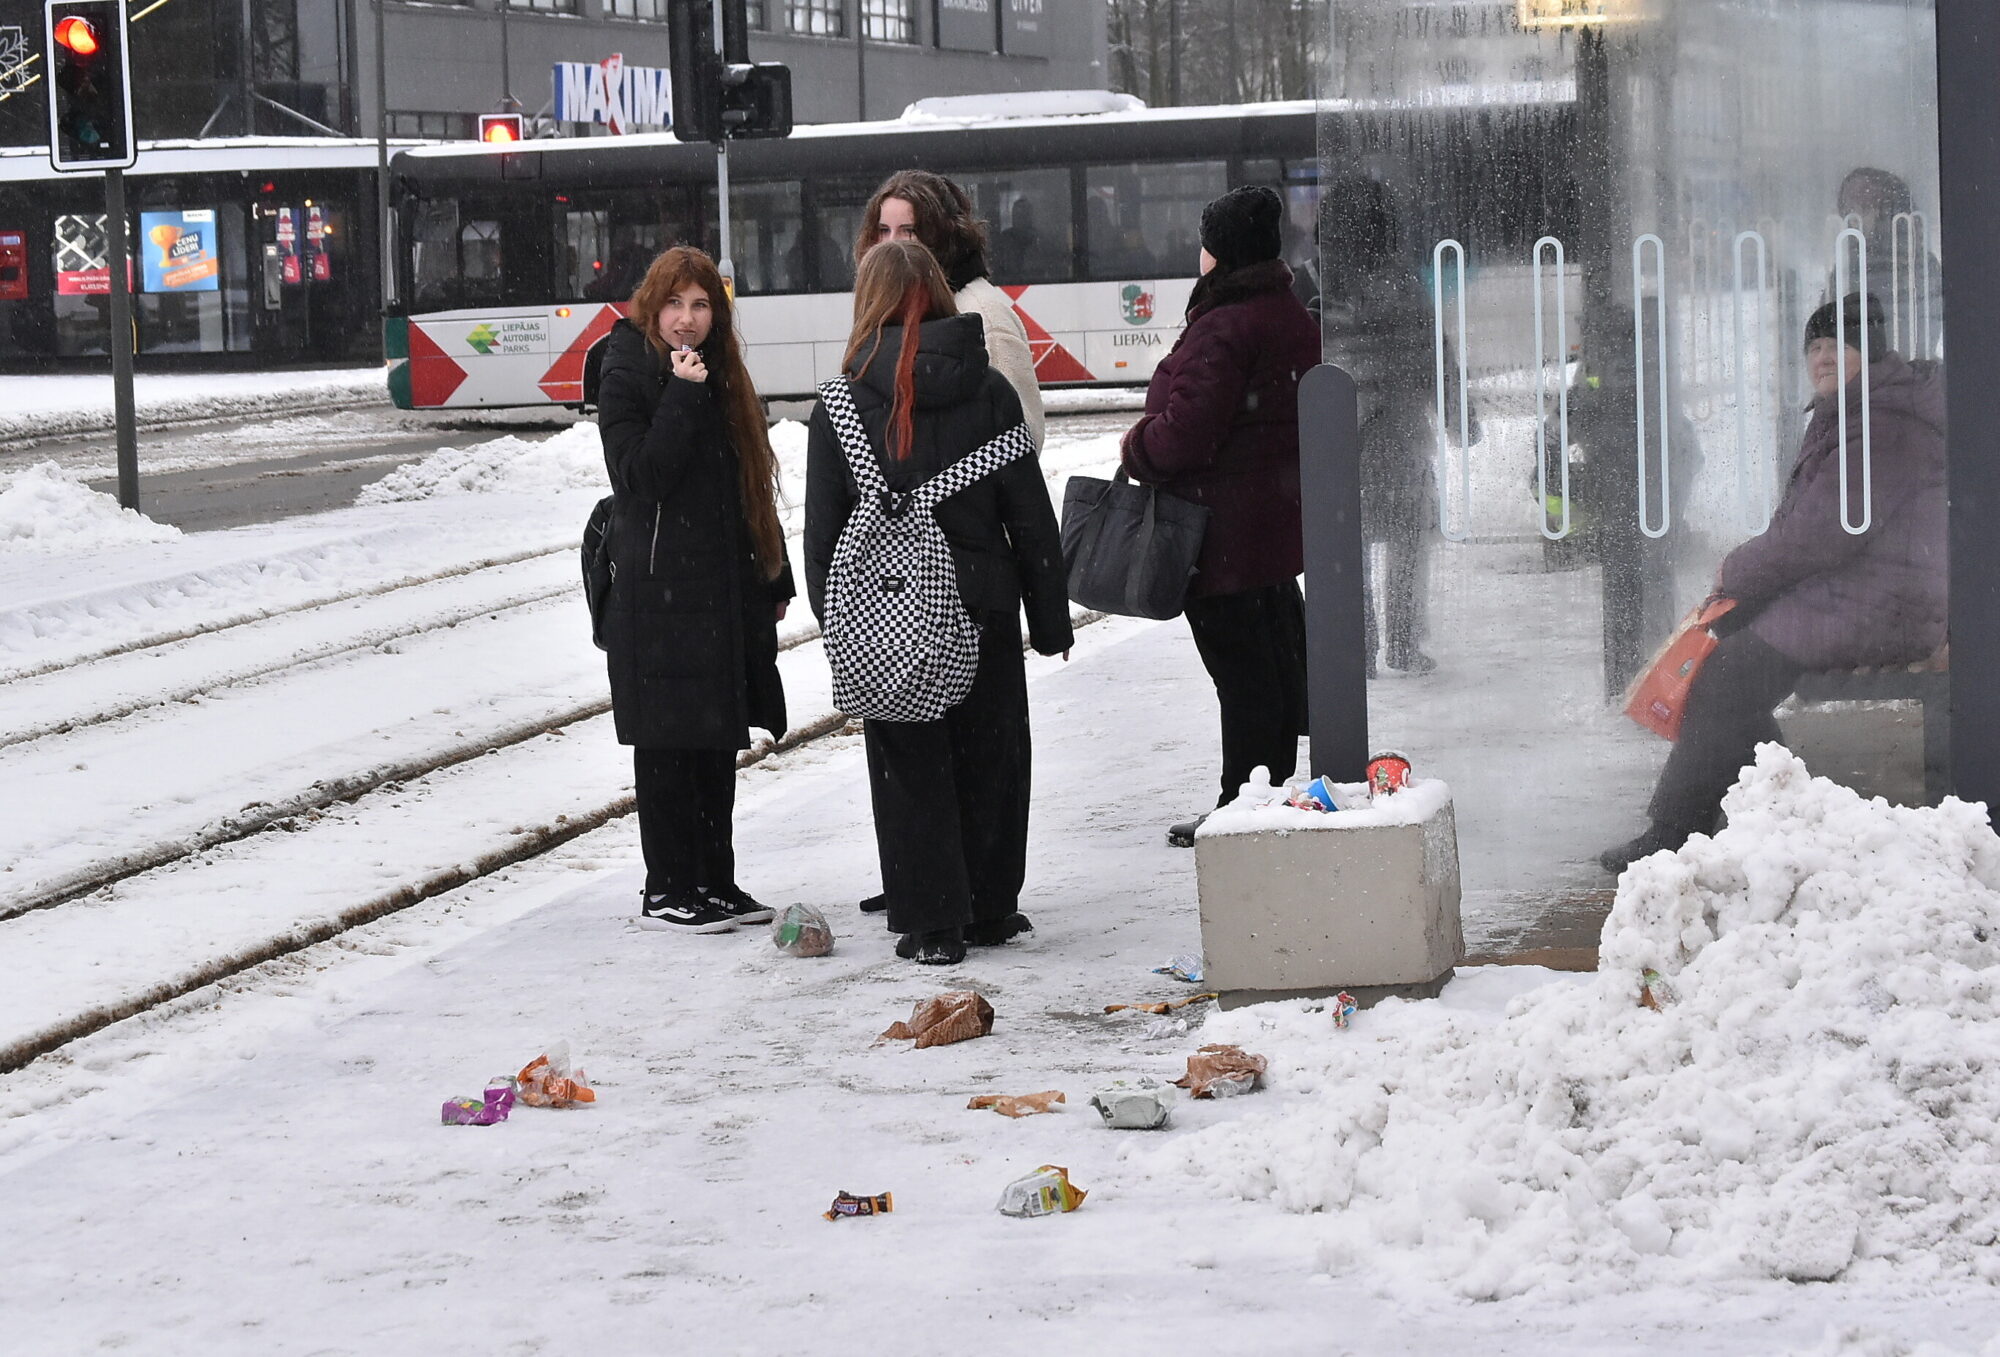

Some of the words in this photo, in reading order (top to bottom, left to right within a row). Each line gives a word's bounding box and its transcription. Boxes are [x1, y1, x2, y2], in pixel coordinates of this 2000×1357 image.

[560, 52, 673, 136] MAXIMA
[502, 321, 540, 332] LIEPĀJAS
[503, 333, 546, 342] AUTOBUSU
[1113, 331, 1161, 347] LIEPĀJA
[503, 344, 530, 353] PARKS
